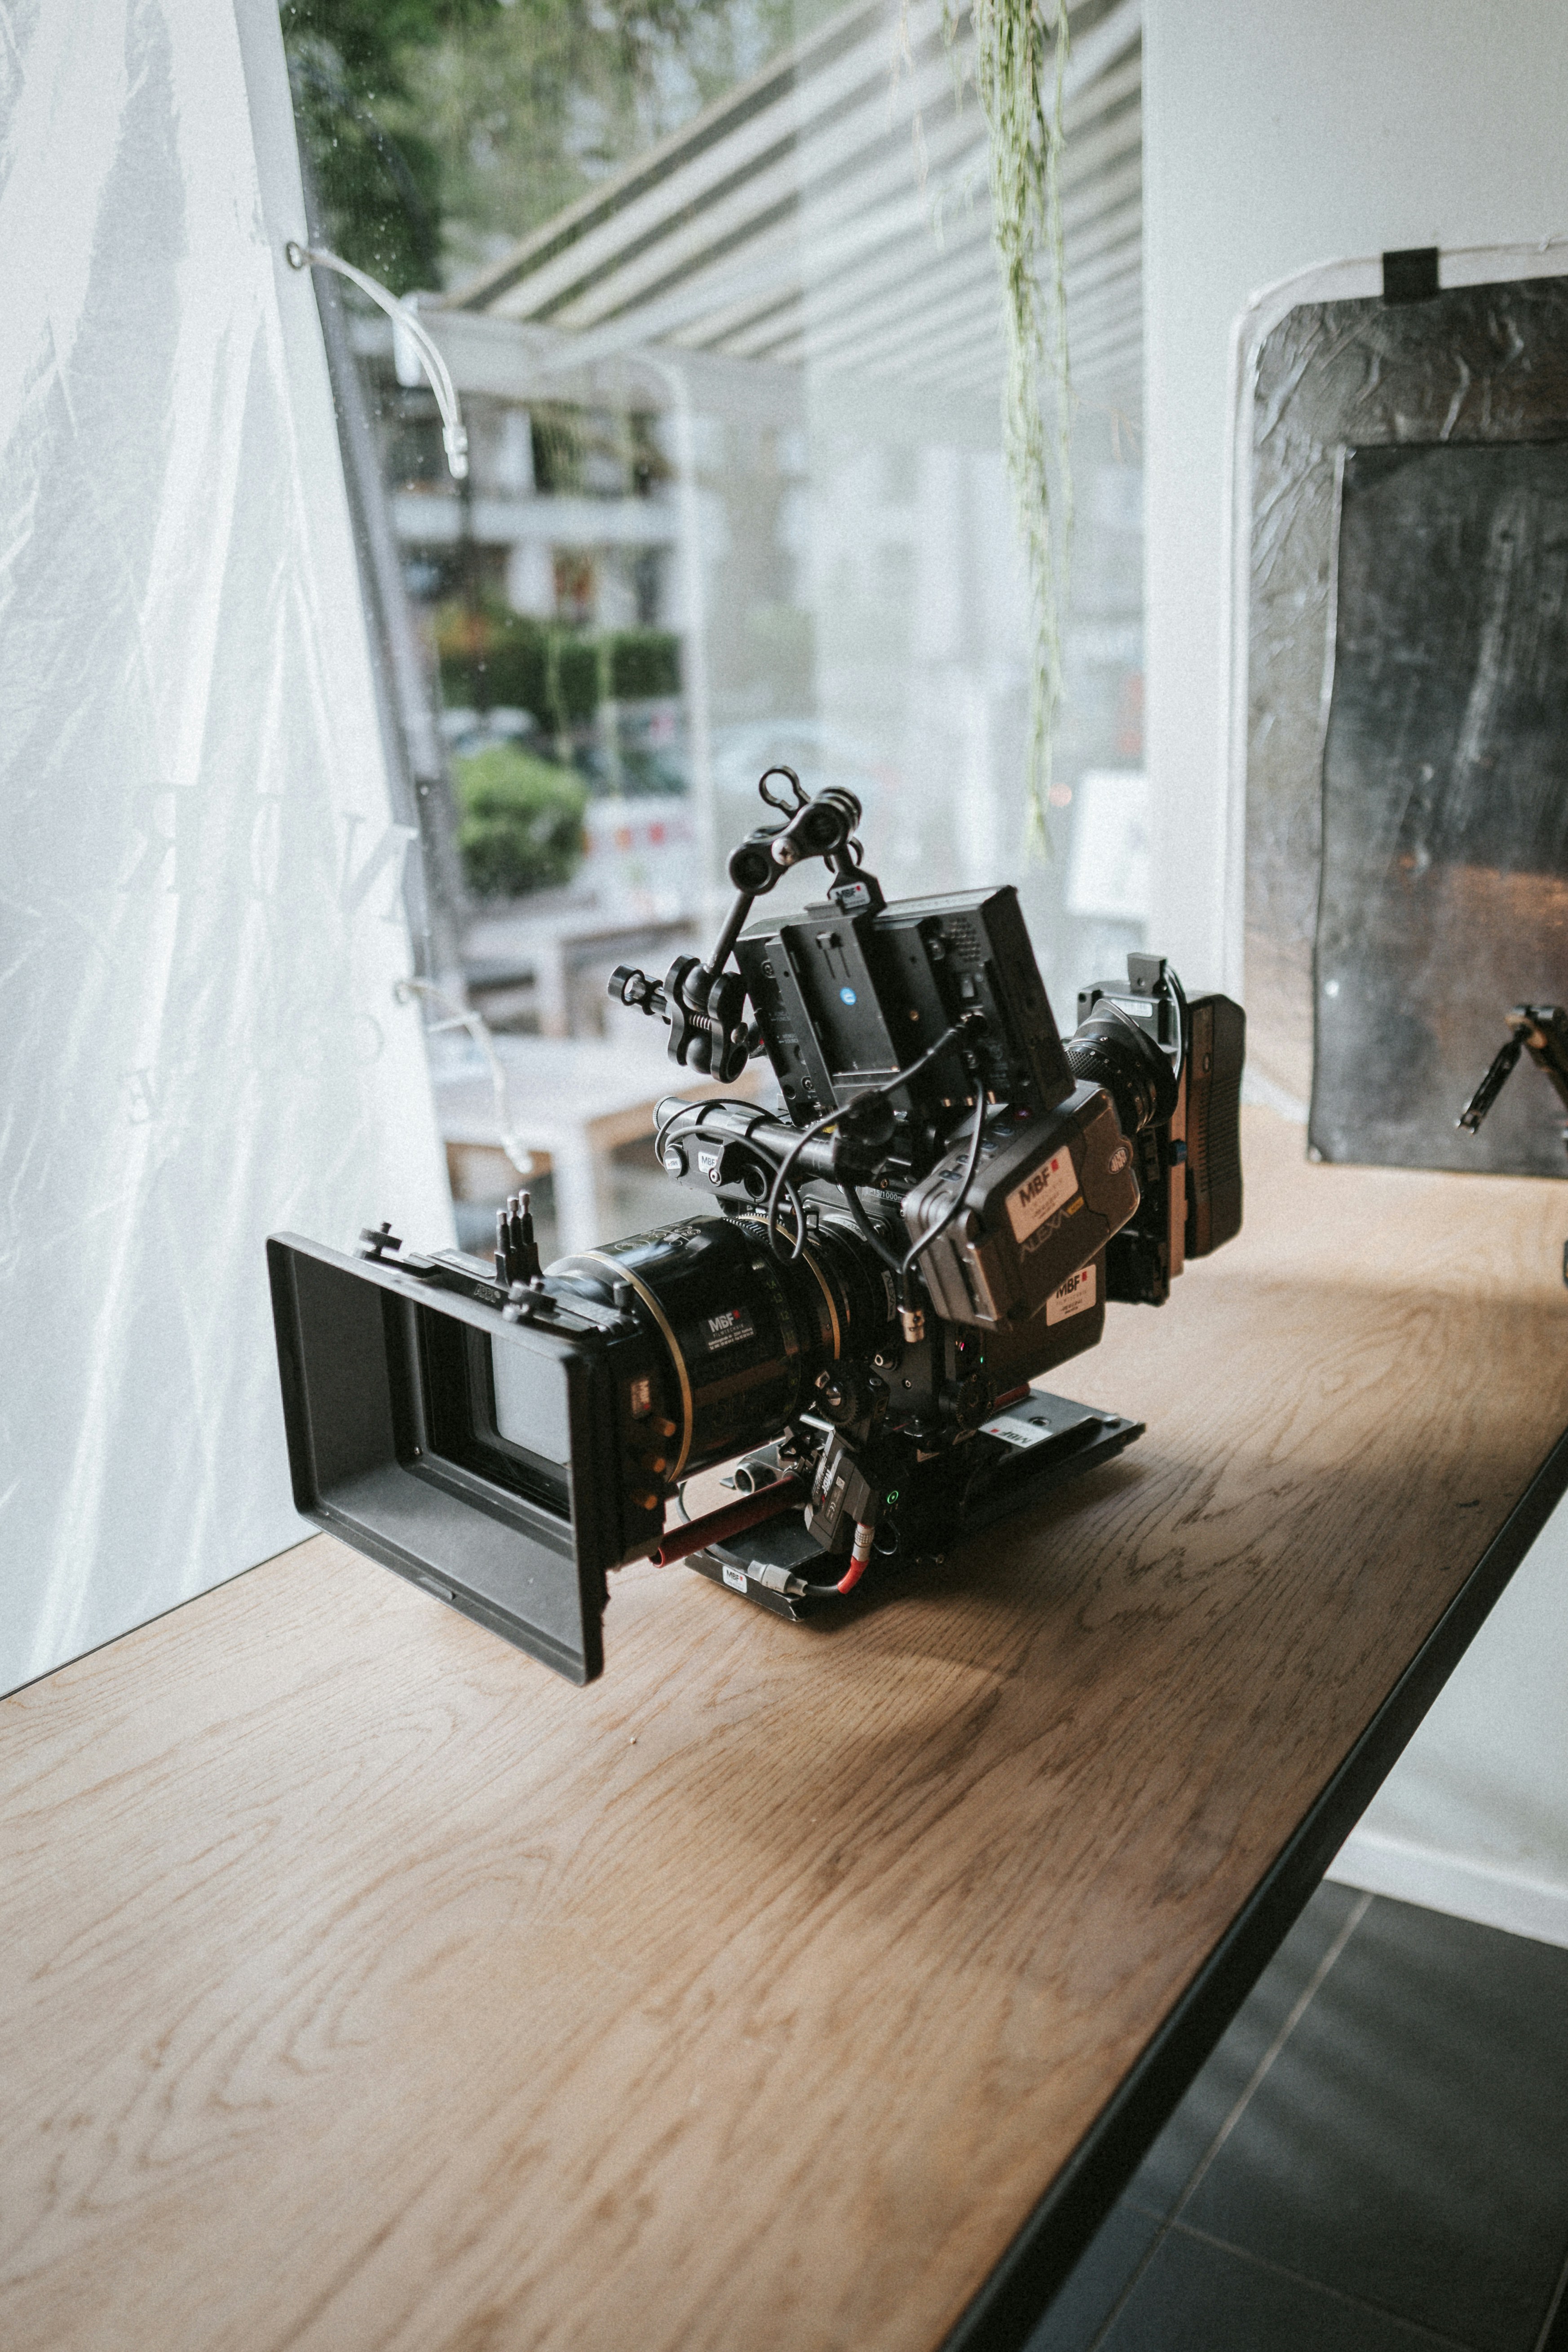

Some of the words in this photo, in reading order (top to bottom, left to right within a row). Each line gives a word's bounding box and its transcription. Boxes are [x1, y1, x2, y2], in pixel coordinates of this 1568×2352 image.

[702, 1156, 715, 1166] MBF
[1018, 1167, 1050, 1207] MBF
[1056, 1274, 1080, 1299] MBF
[708, 1312, 734, 1333] MBF
[999, 1432, 1033, 1444] MBF
[726, 1569, 740, 1582] MBF
